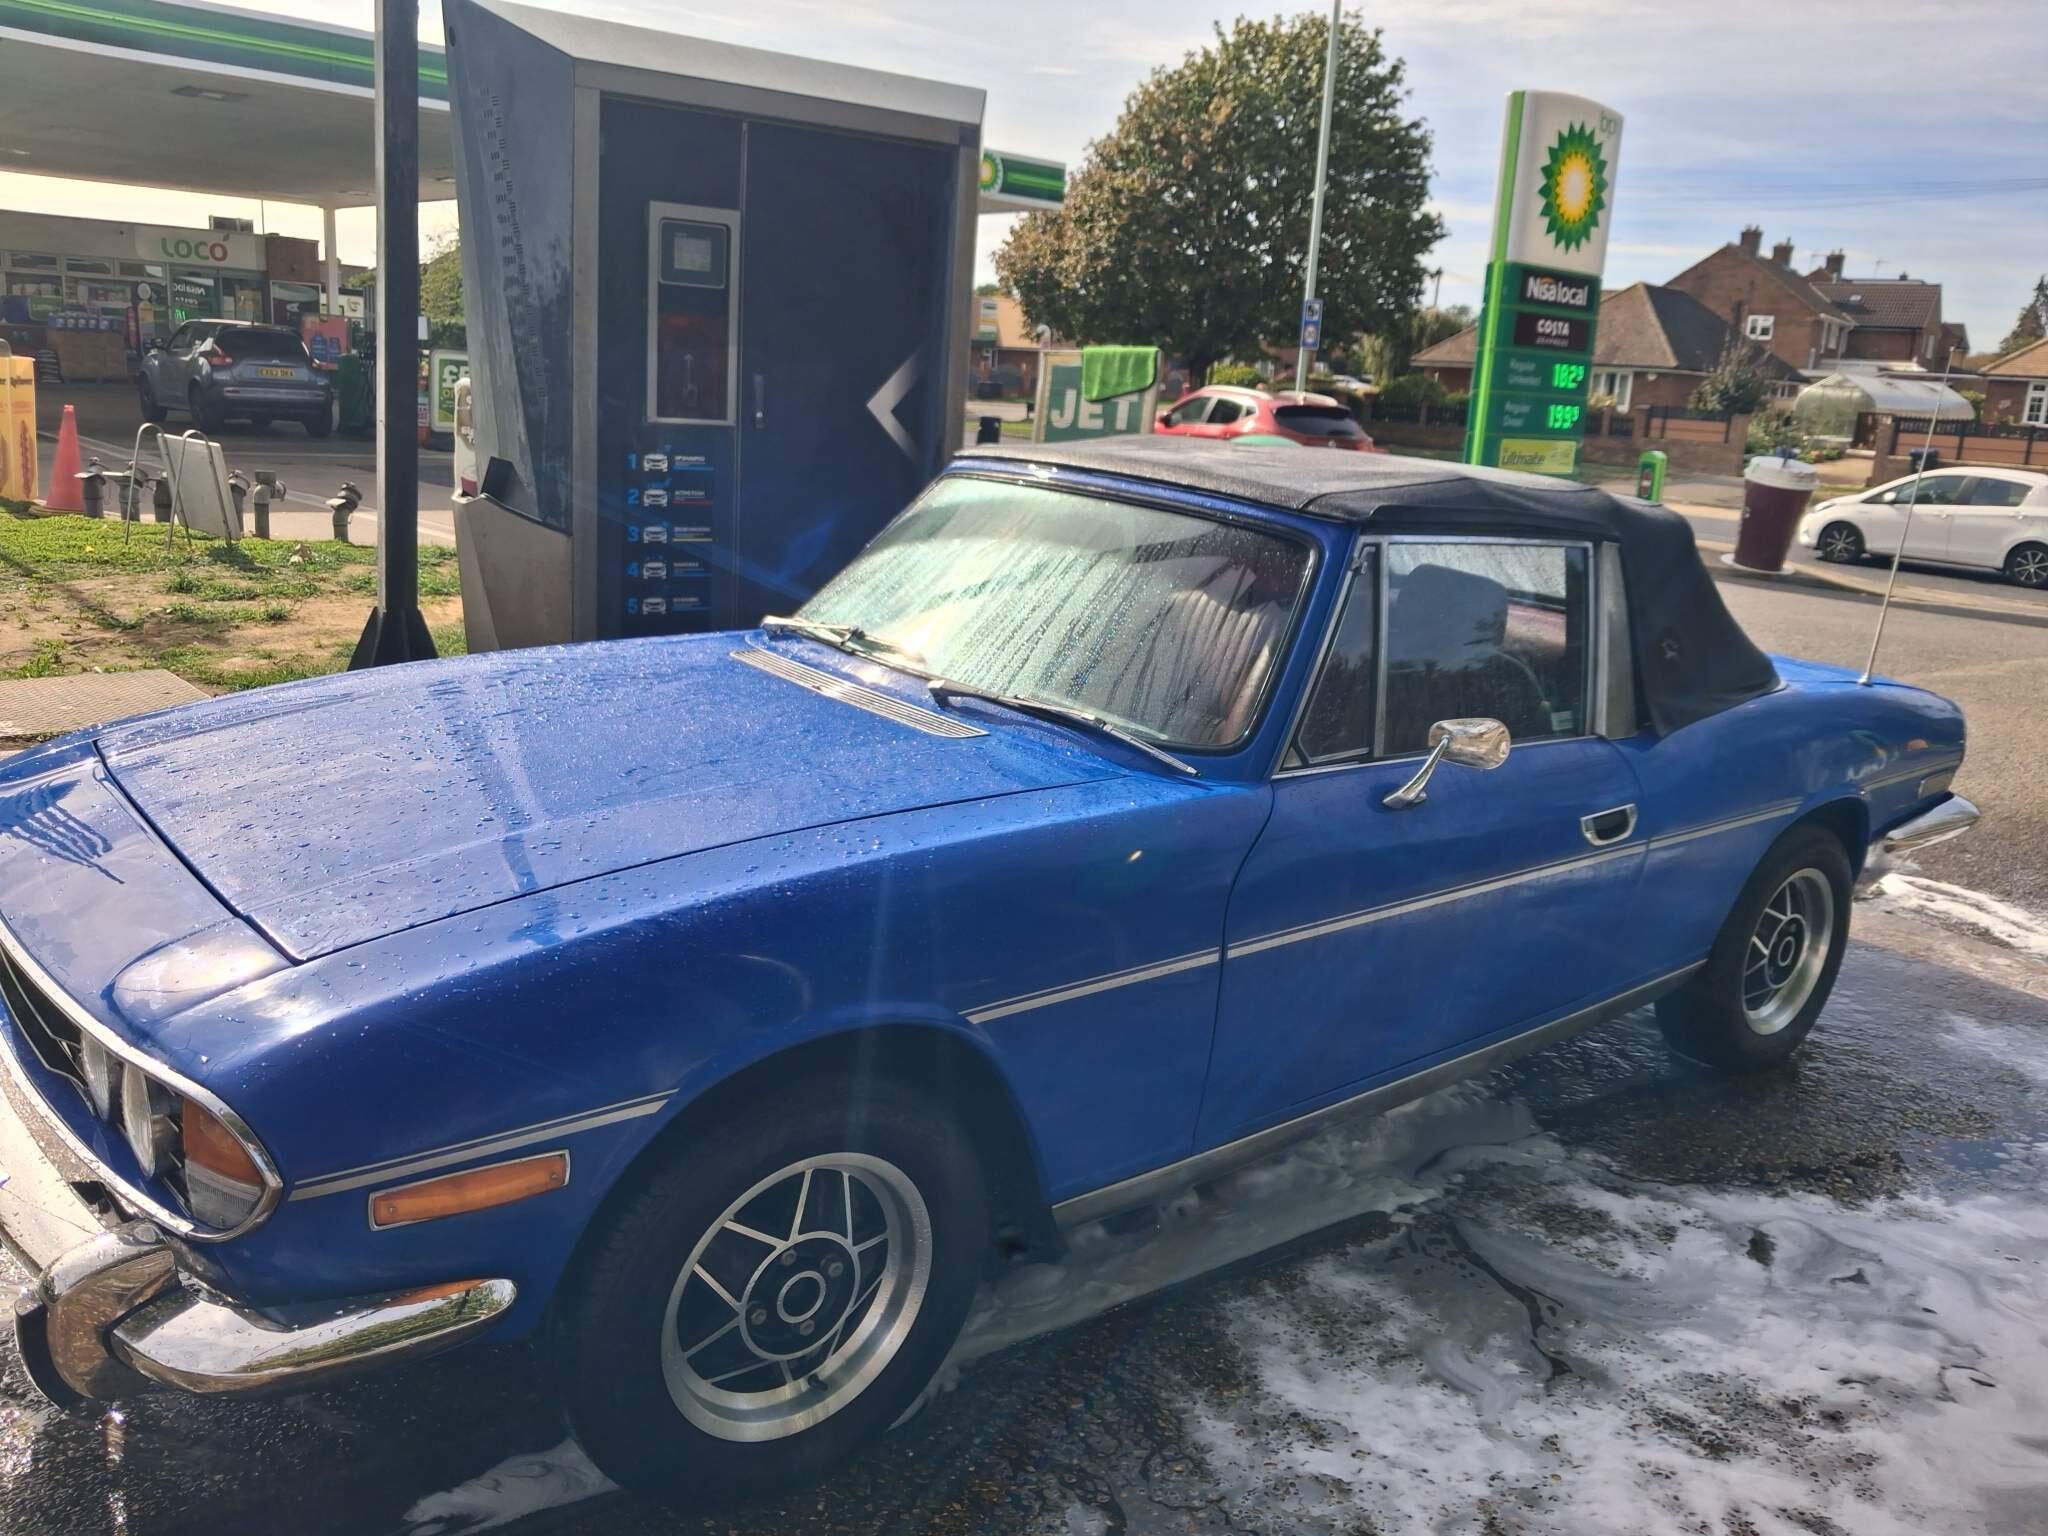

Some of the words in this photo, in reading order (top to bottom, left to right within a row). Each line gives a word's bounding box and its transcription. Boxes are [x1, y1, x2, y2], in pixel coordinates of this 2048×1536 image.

[1600, 108, 1617, 140] bp
[161, 236, 229, 263] LOCO
[1537, 319, 1570, 336] COSTA
[1051, 389, 1139, 431] JET
[627, 453, 637, 471] 1
[627, 488, 639, 505] 2
[627, 526, 639, 542] 3
[626, 562, 639, 577] 4
